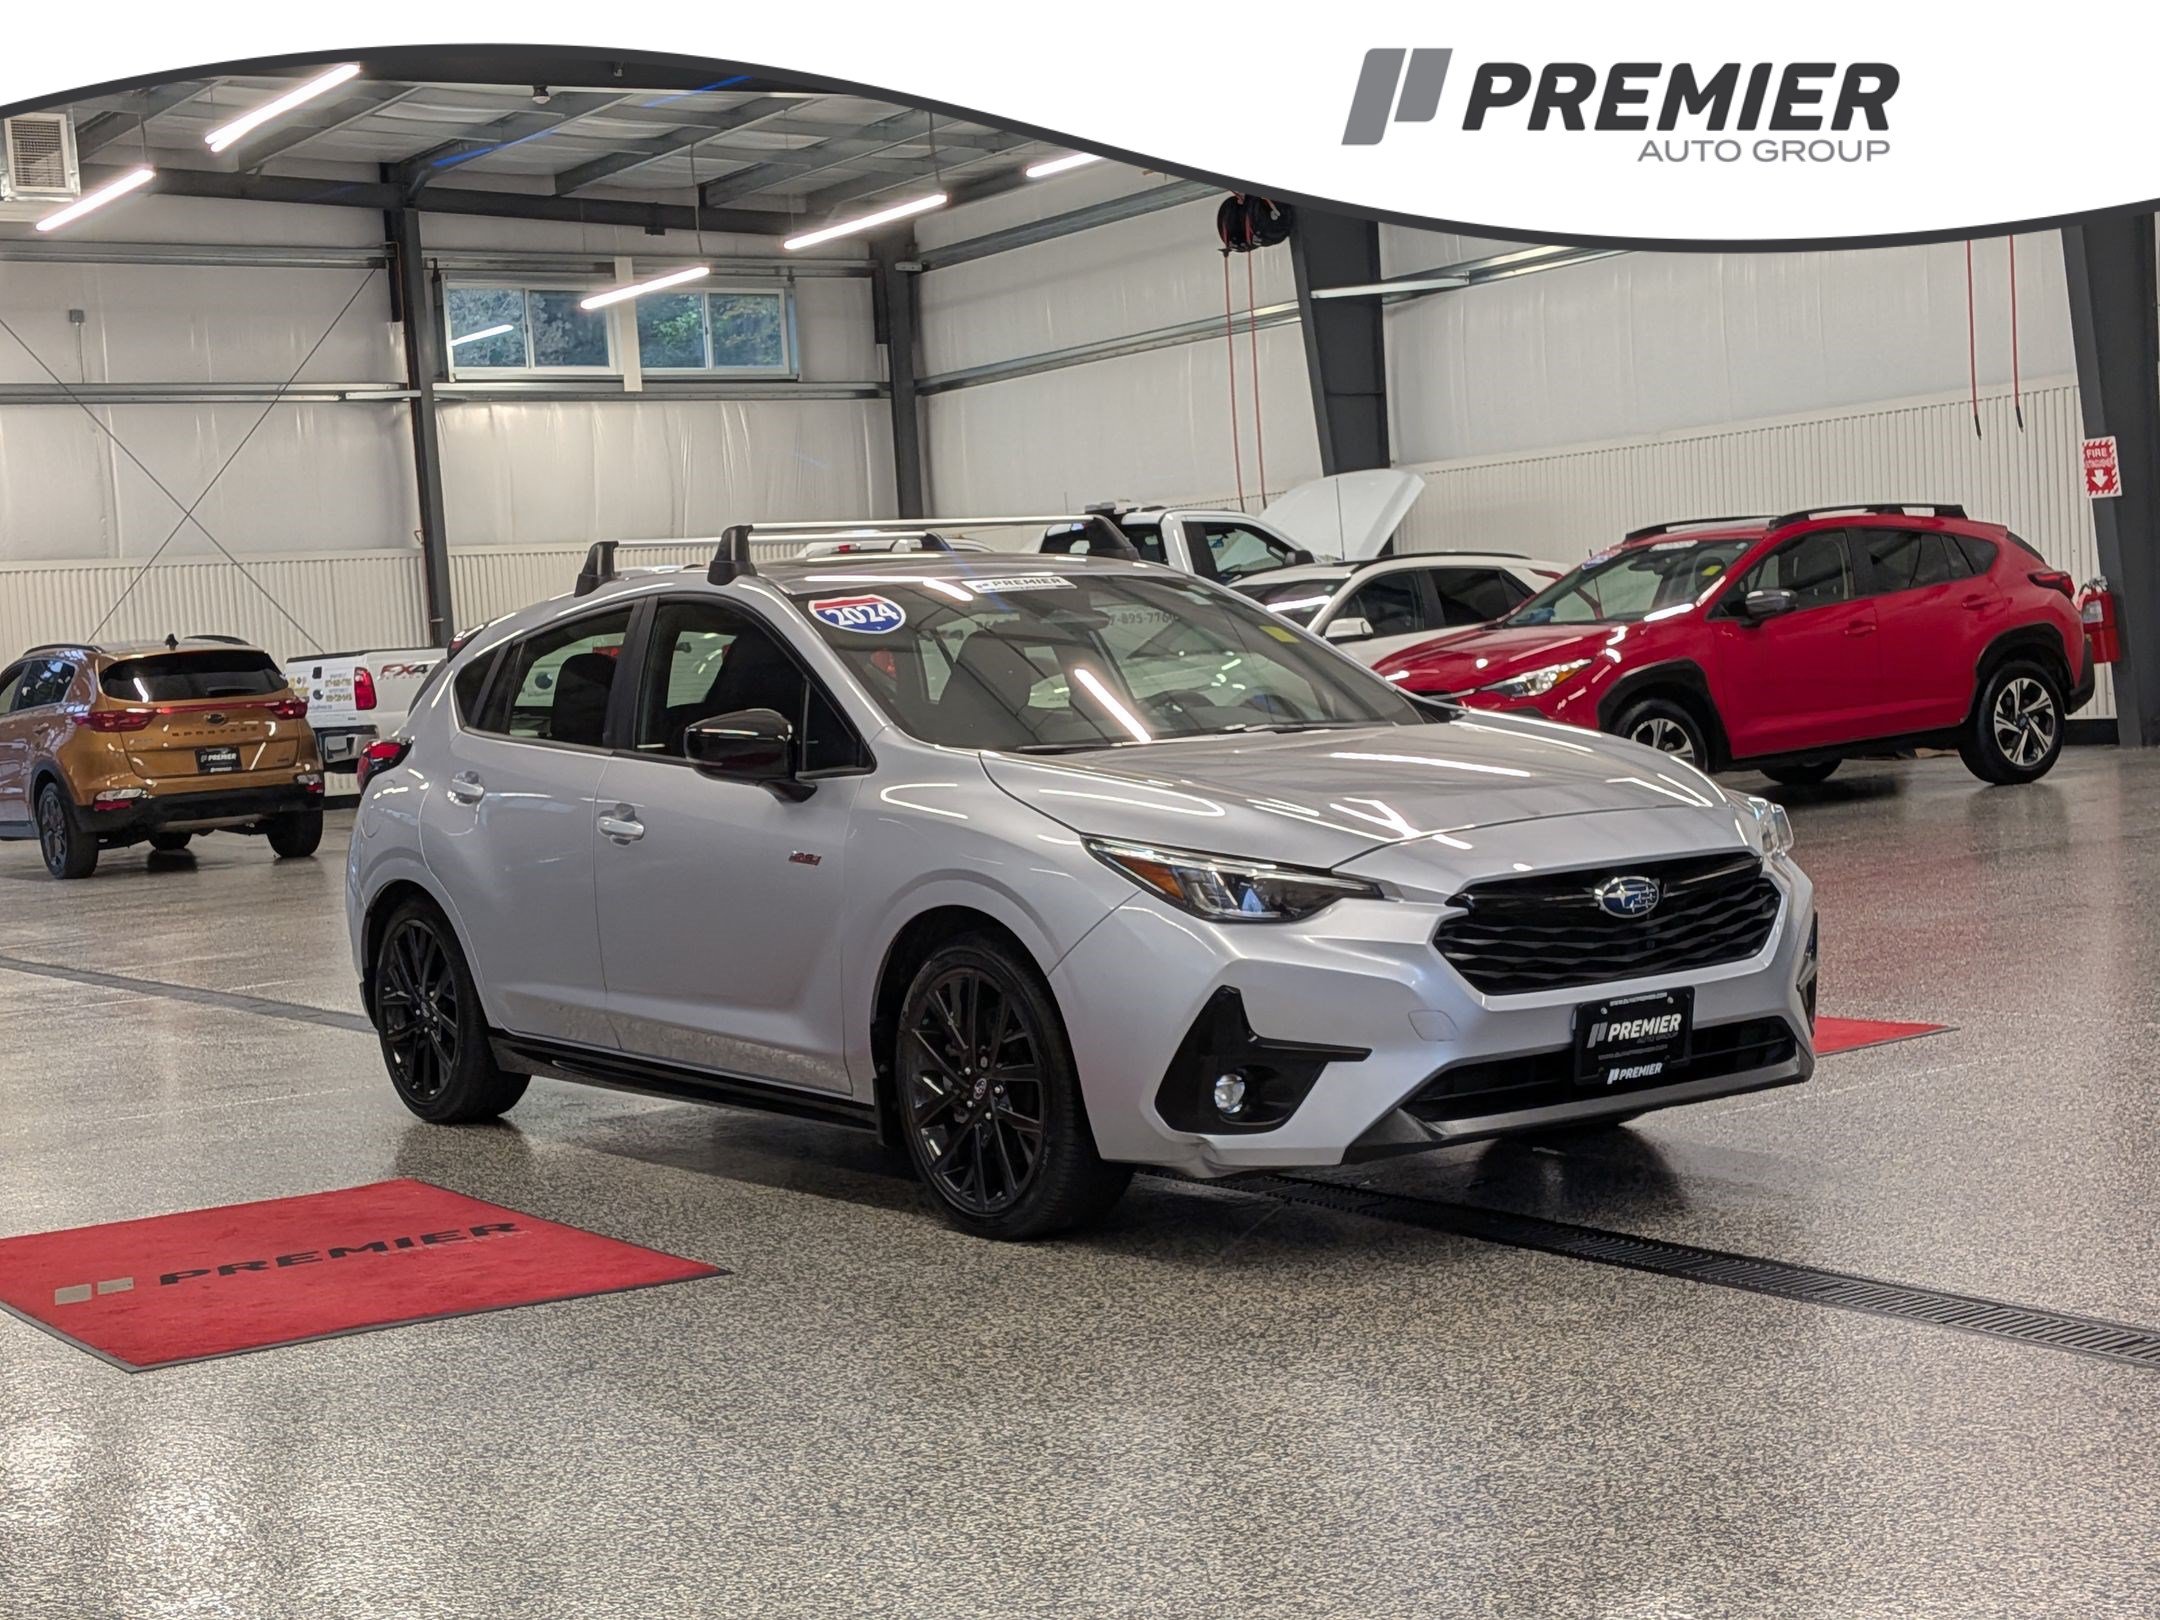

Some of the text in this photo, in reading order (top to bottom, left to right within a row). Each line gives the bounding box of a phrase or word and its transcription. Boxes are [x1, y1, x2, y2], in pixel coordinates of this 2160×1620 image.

[2086, 448, 2108, 458] FIRE
[992, 578, 1062, 586] PREMIER
[824, 603, 900, 626] 2024
[380, 663, 429, 677] FX4
[1608, 1013, 1681, 1042] PREMIER
[1619, 1062, 1663, 1080] PREMIER
[159, 1223, 518, 1286] PREMIER
